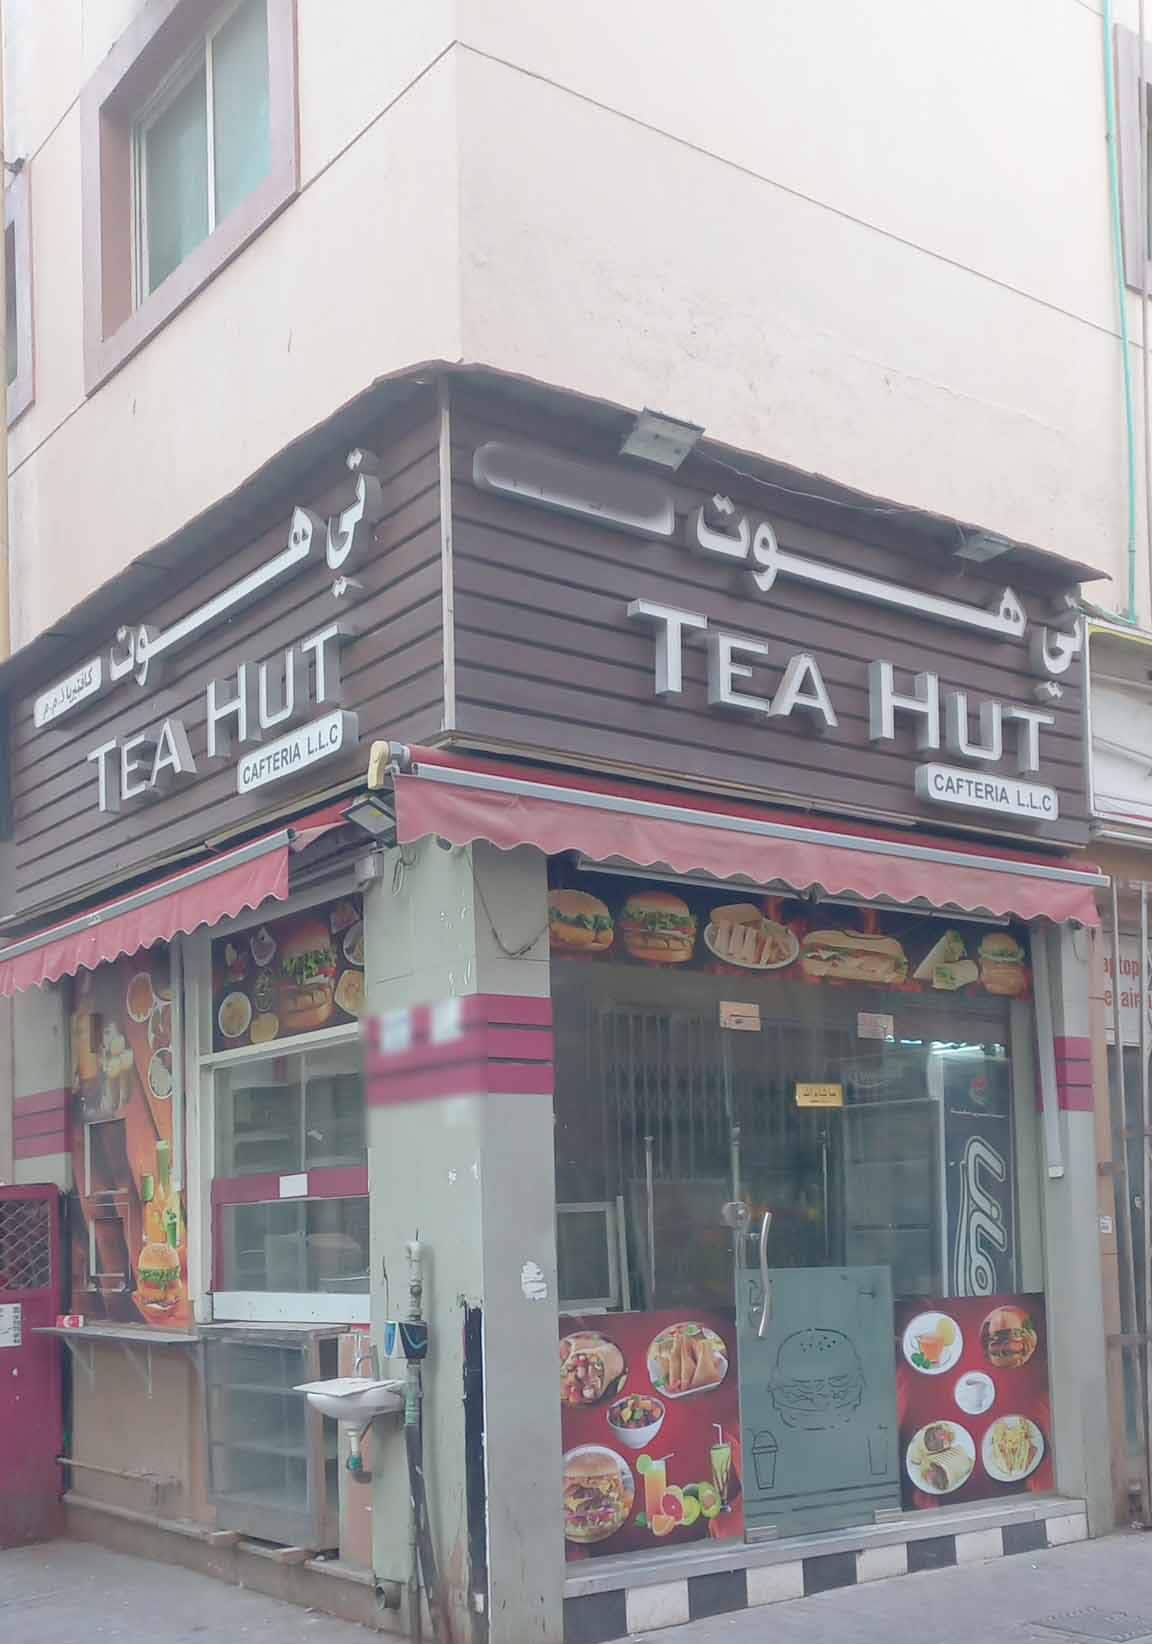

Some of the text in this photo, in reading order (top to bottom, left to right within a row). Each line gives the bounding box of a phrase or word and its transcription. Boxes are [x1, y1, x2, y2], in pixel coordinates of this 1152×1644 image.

[697, 493, 1026, 638] هوت
[87, 623, 345, 813] TEA HUT
[243, 723, 338, 784] CAFTERIA L.L.C
[626, 599, 1056, 773] TEA HUT
[934, 774, 1052, 812] CAFTERIA L.L.C
